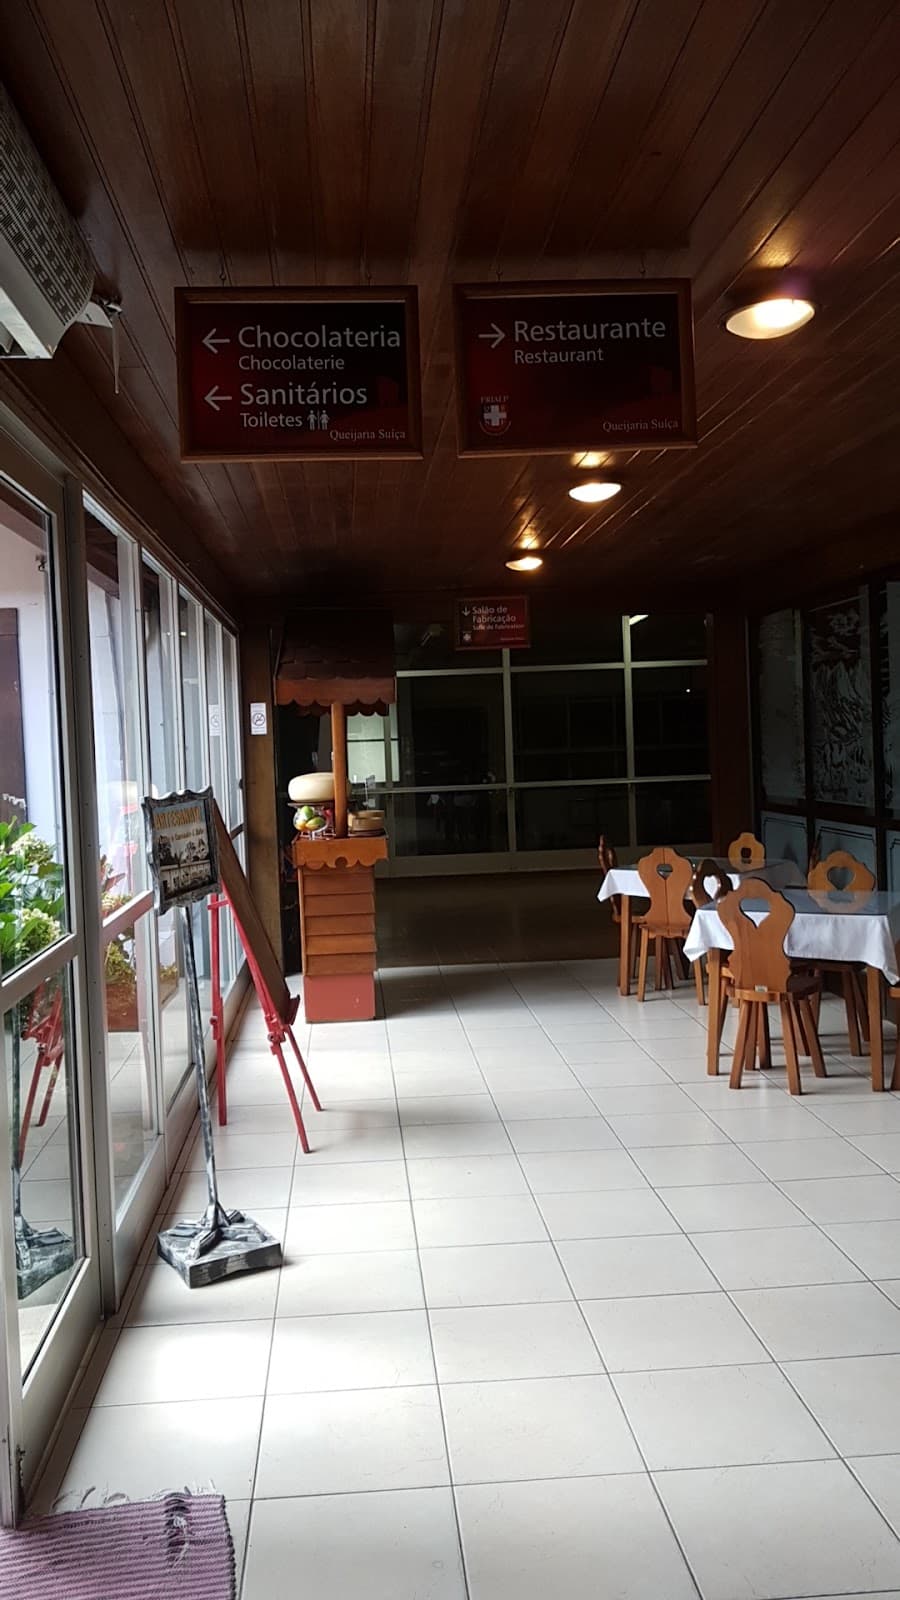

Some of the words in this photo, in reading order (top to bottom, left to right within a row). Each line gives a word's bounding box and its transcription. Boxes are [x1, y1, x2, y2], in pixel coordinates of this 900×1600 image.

[238, 324, 400, 349] Chocolateria
[514, 318, 667, 343] Restaurante
[238, 354, 345, 371] Chocolaterie
[514, 348, 604, 365] Restaurant
[240, 380, 368, 406] Sanitários
[240, 411, 303, 428] Toiletes
[602, 420, 649, 432] Queijaria
[329, 429, 376, 441] Queijaria
[472, 606, 495, 615] Salão
[496, 605, 508, 614] de
[472, 614, 517, 624] Fabricação
